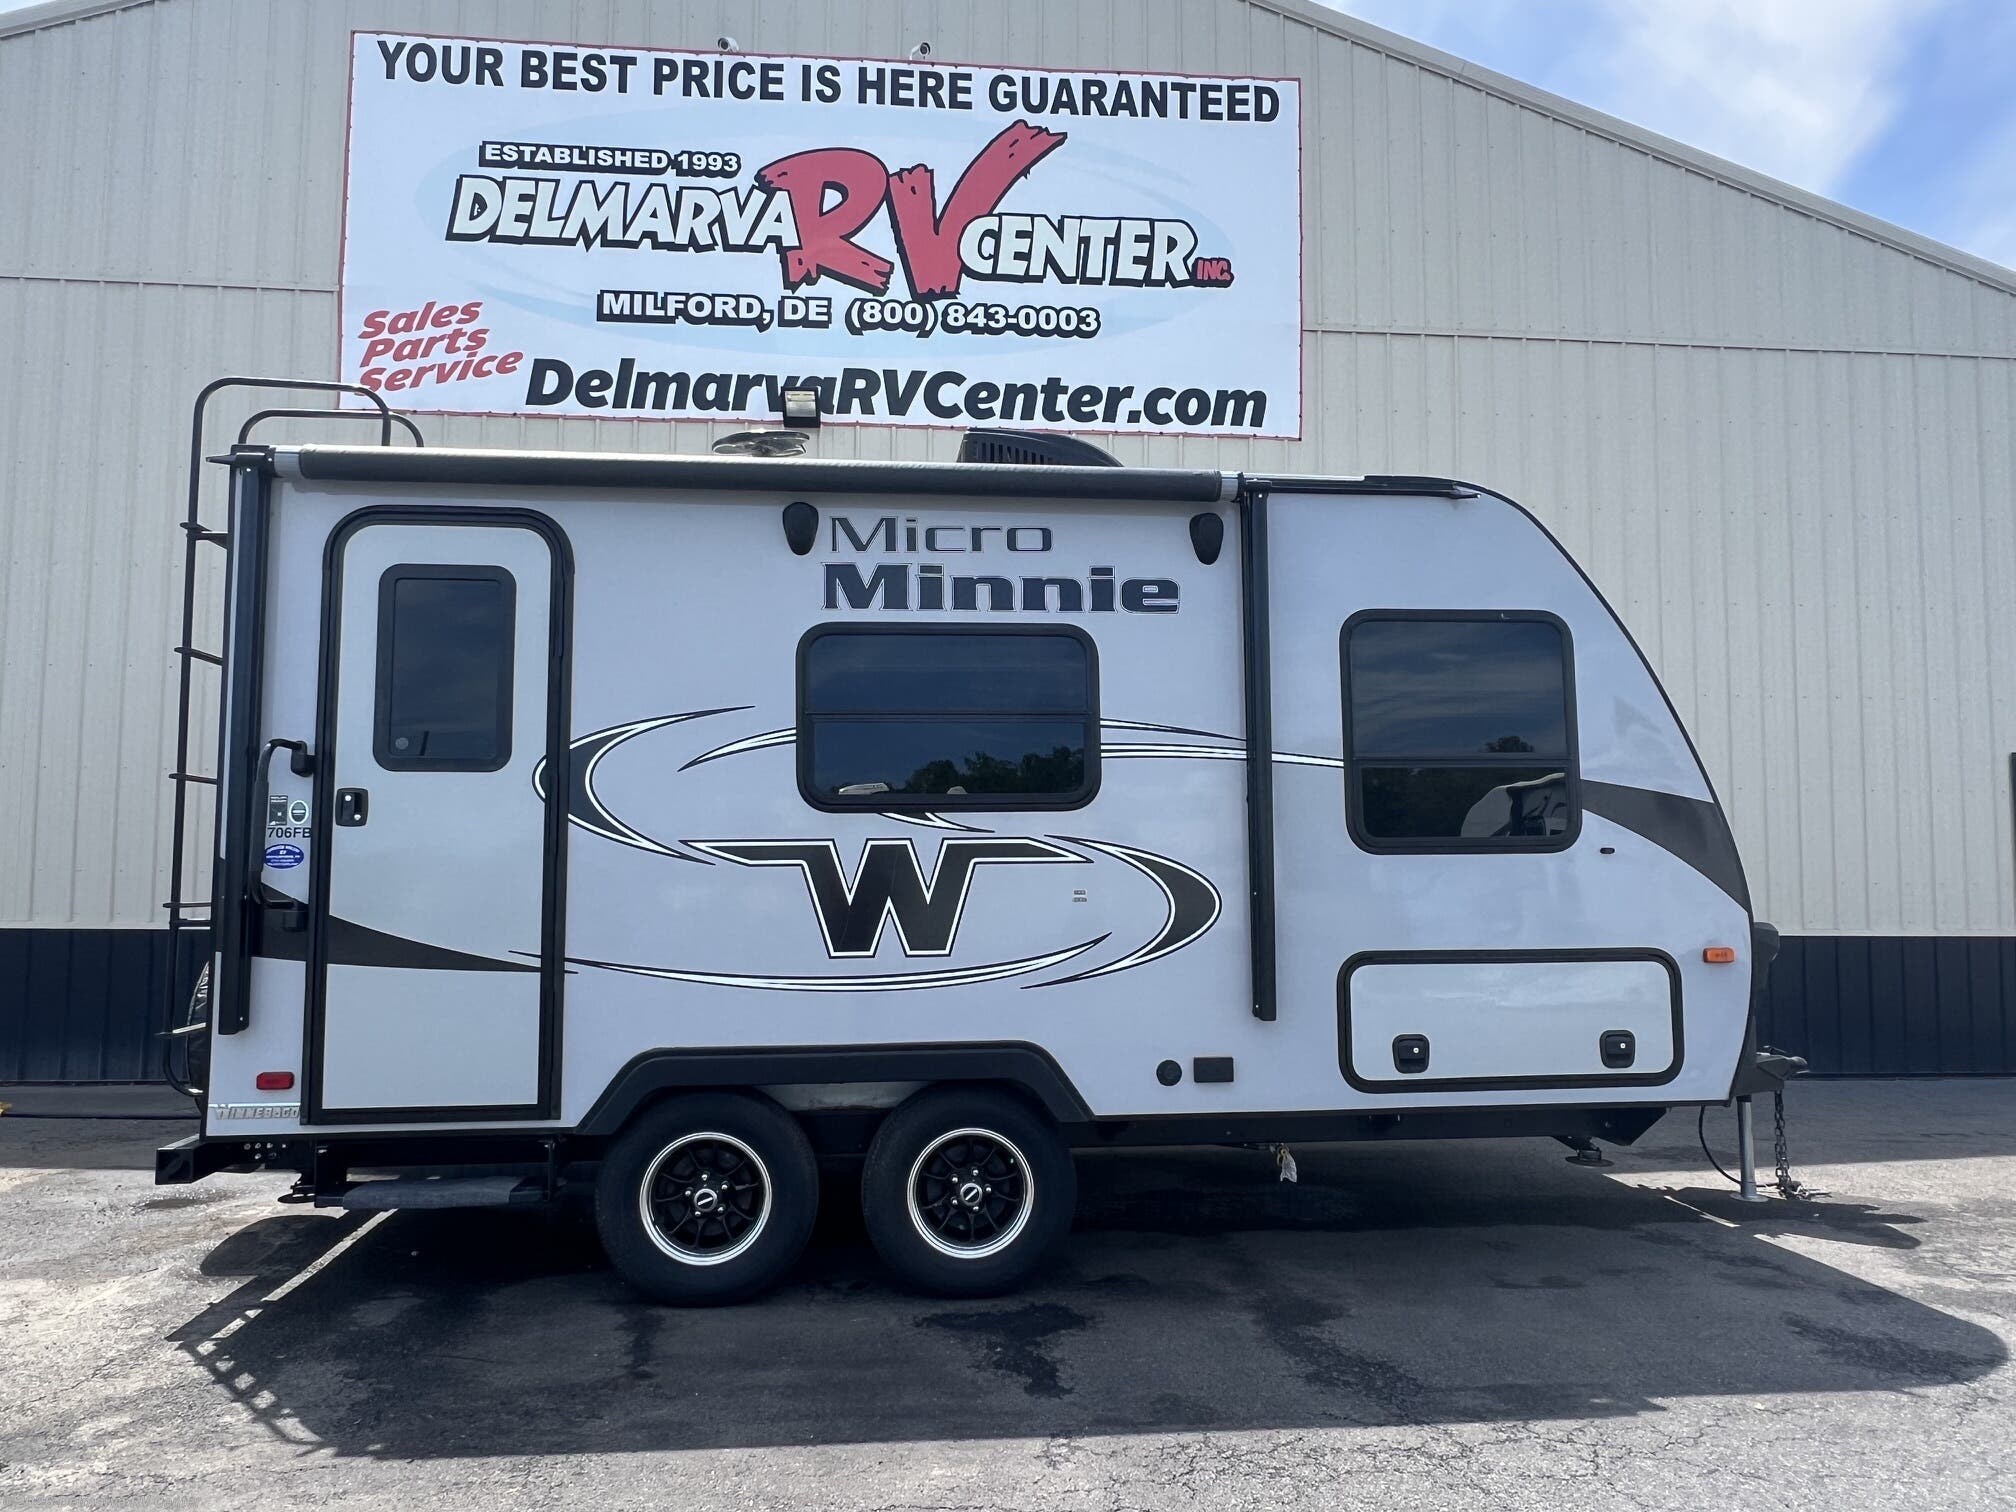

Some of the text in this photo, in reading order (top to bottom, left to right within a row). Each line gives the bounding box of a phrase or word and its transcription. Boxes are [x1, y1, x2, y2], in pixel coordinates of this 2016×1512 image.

[377, 40, 1280, 122] YOUR BEST PRICE IS HERE GUARANTEED
[483, 143, 739, 173] ESTABLISHED 1993
[448, 174, 802, 252] DELMARVA
[755, 119, 1067, 299] RV
[957, 213, 1198, 286] CENTER
[358, 301, 483, 339] Sales
[600, 291, 1100, 334] MILFORD, DE (800) 843-0003
[360, 328, 490, 368] Parts
[355, 351, 524, 396] Service
[829, 515, 1053, 554] Micro
[820, 561, 1181, 614] Minnie
